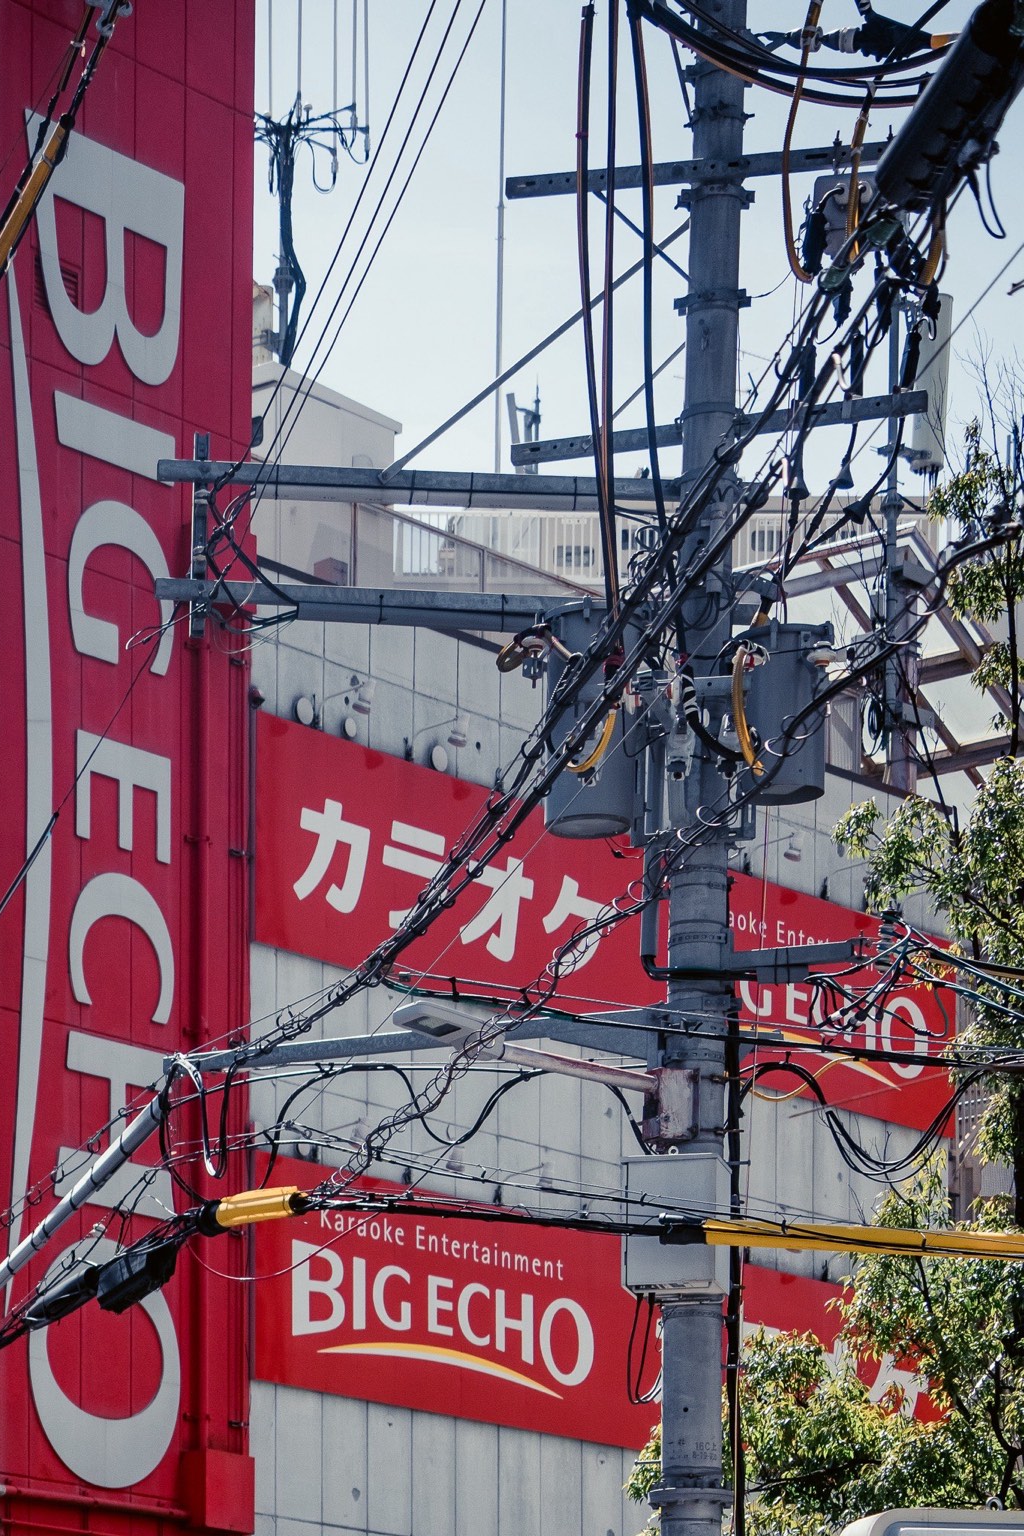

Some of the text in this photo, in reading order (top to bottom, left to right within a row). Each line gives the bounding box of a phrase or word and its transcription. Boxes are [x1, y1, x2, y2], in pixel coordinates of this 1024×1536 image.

[24, 107, 186, 1490] BIG ECHO
[291, 1238, 412, 1337] BIG
[427, 1274, 595, 1387] ECHO
[319, 1209, 565, 1281] Karaoke Entertainment
